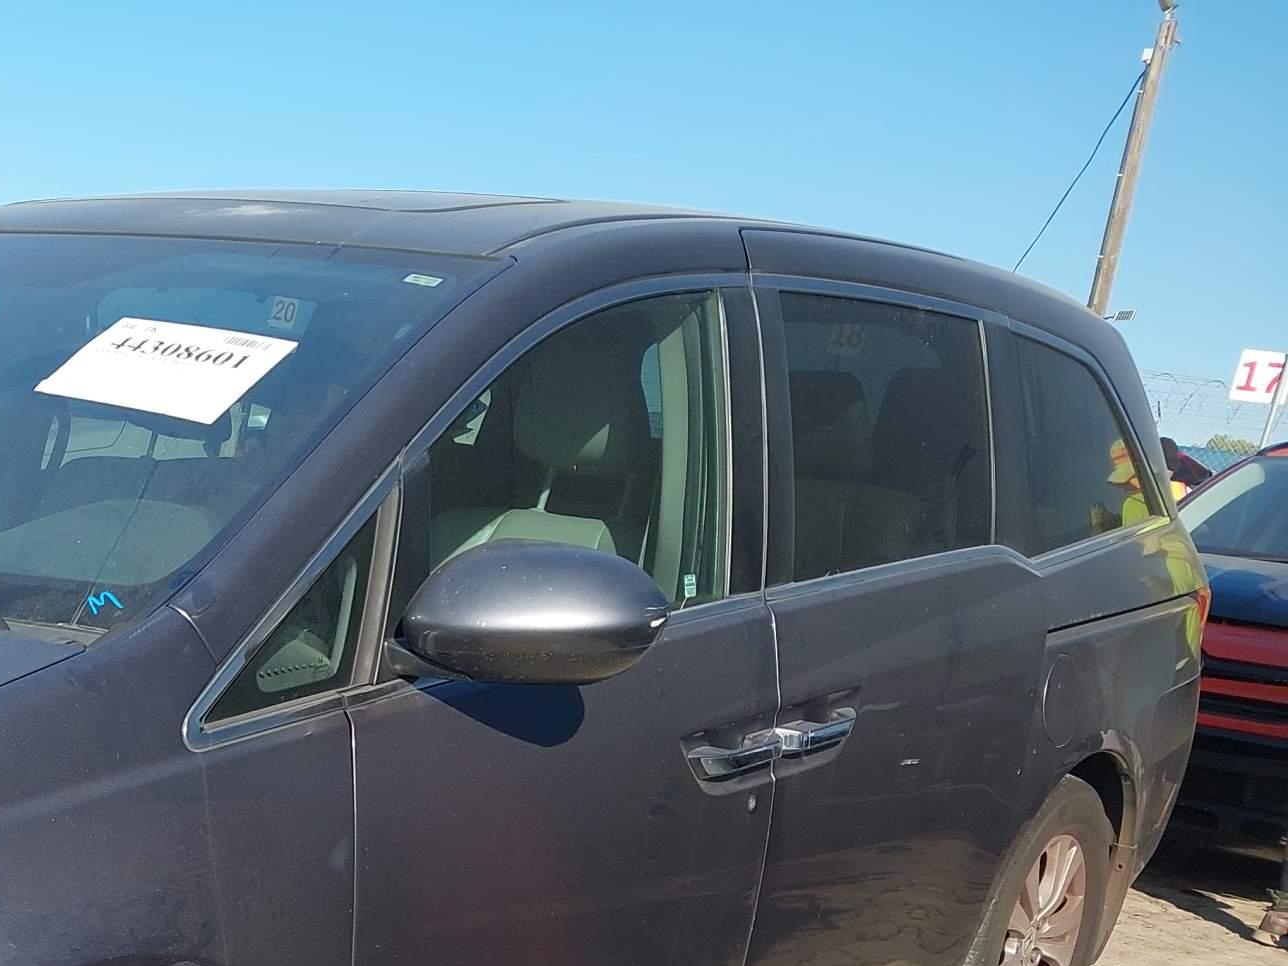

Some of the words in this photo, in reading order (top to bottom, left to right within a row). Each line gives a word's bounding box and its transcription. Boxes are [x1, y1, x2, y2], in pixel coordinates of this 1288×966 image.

[272, 300, 296, 323] 20
[111, 337, 250, 368] 44308601
[1236, 361, 1284, 393] 17
